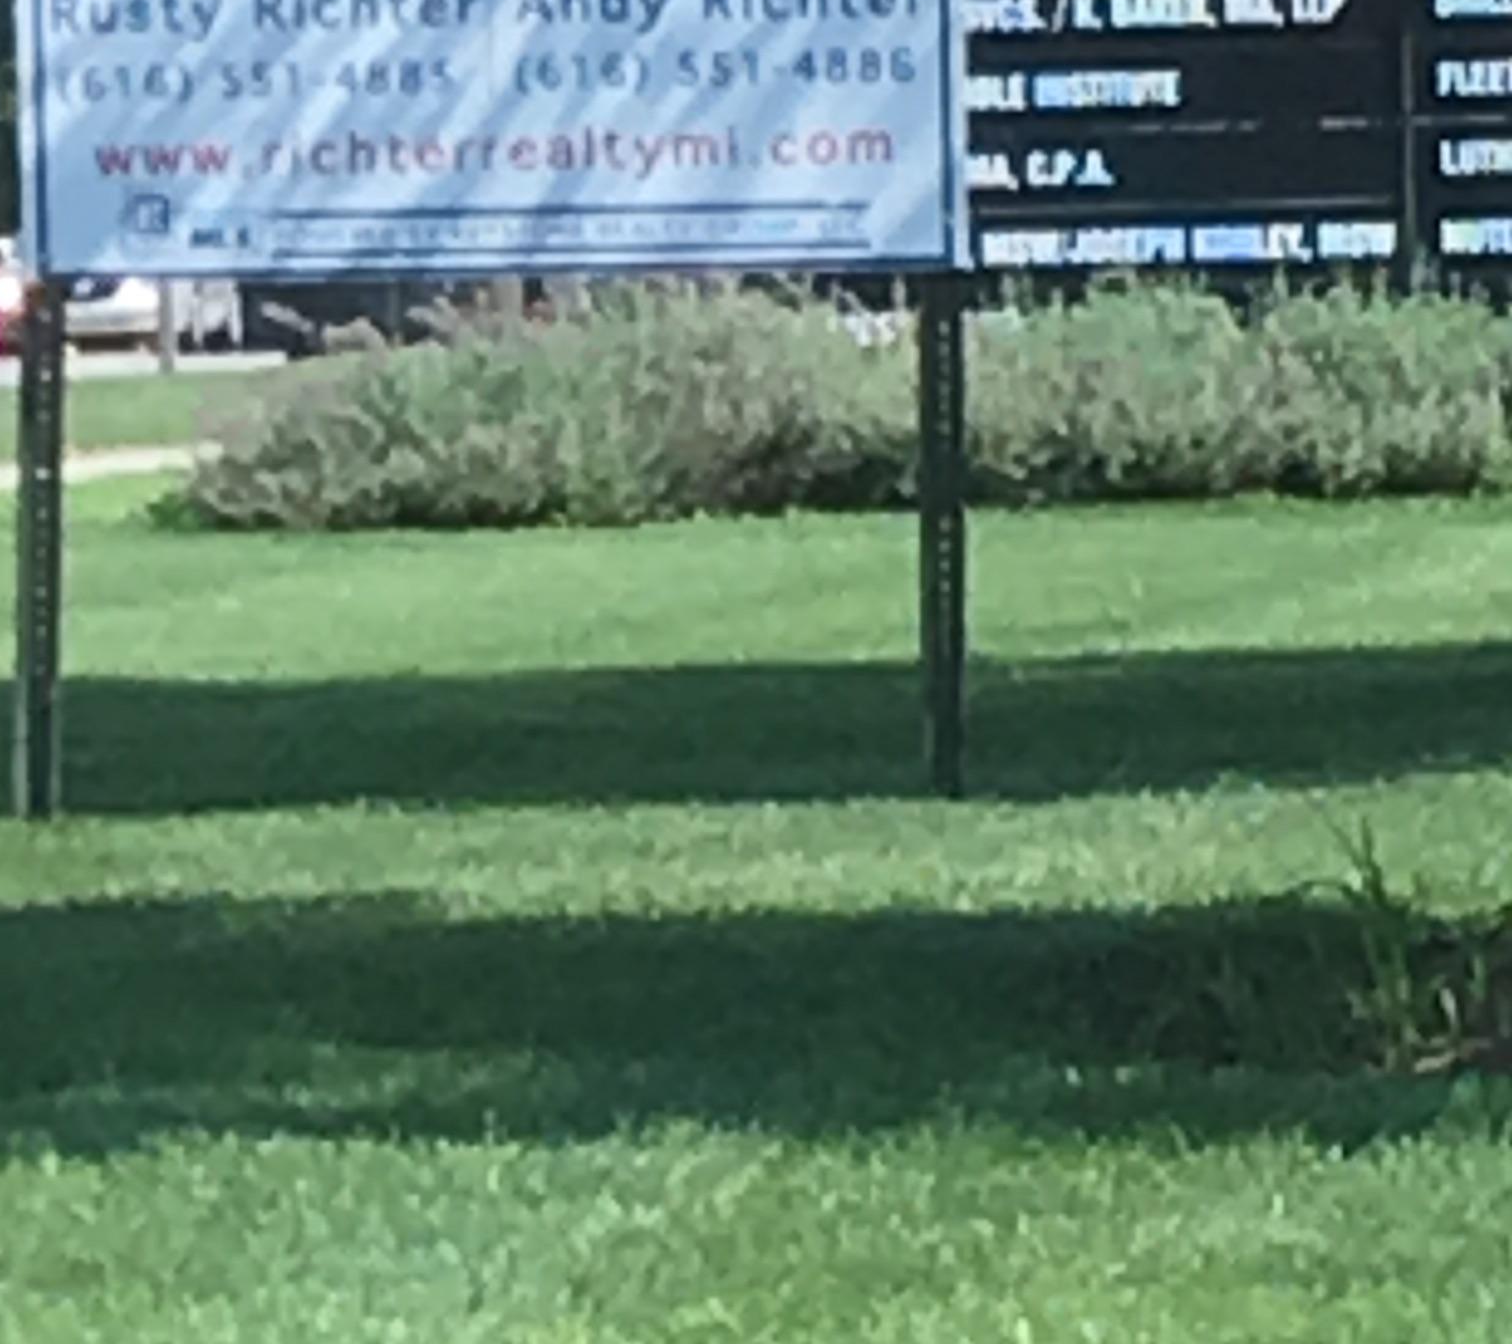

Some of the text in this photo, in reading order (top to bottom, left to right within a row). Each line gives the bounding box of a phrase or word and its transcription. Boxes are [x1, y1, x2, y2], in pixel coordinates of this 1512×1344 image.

[56, 61, 194, 104] (616)
[516, 51, 650, 95] (616)
[94, 127, 895, 180] www.richterrealtymi.com
